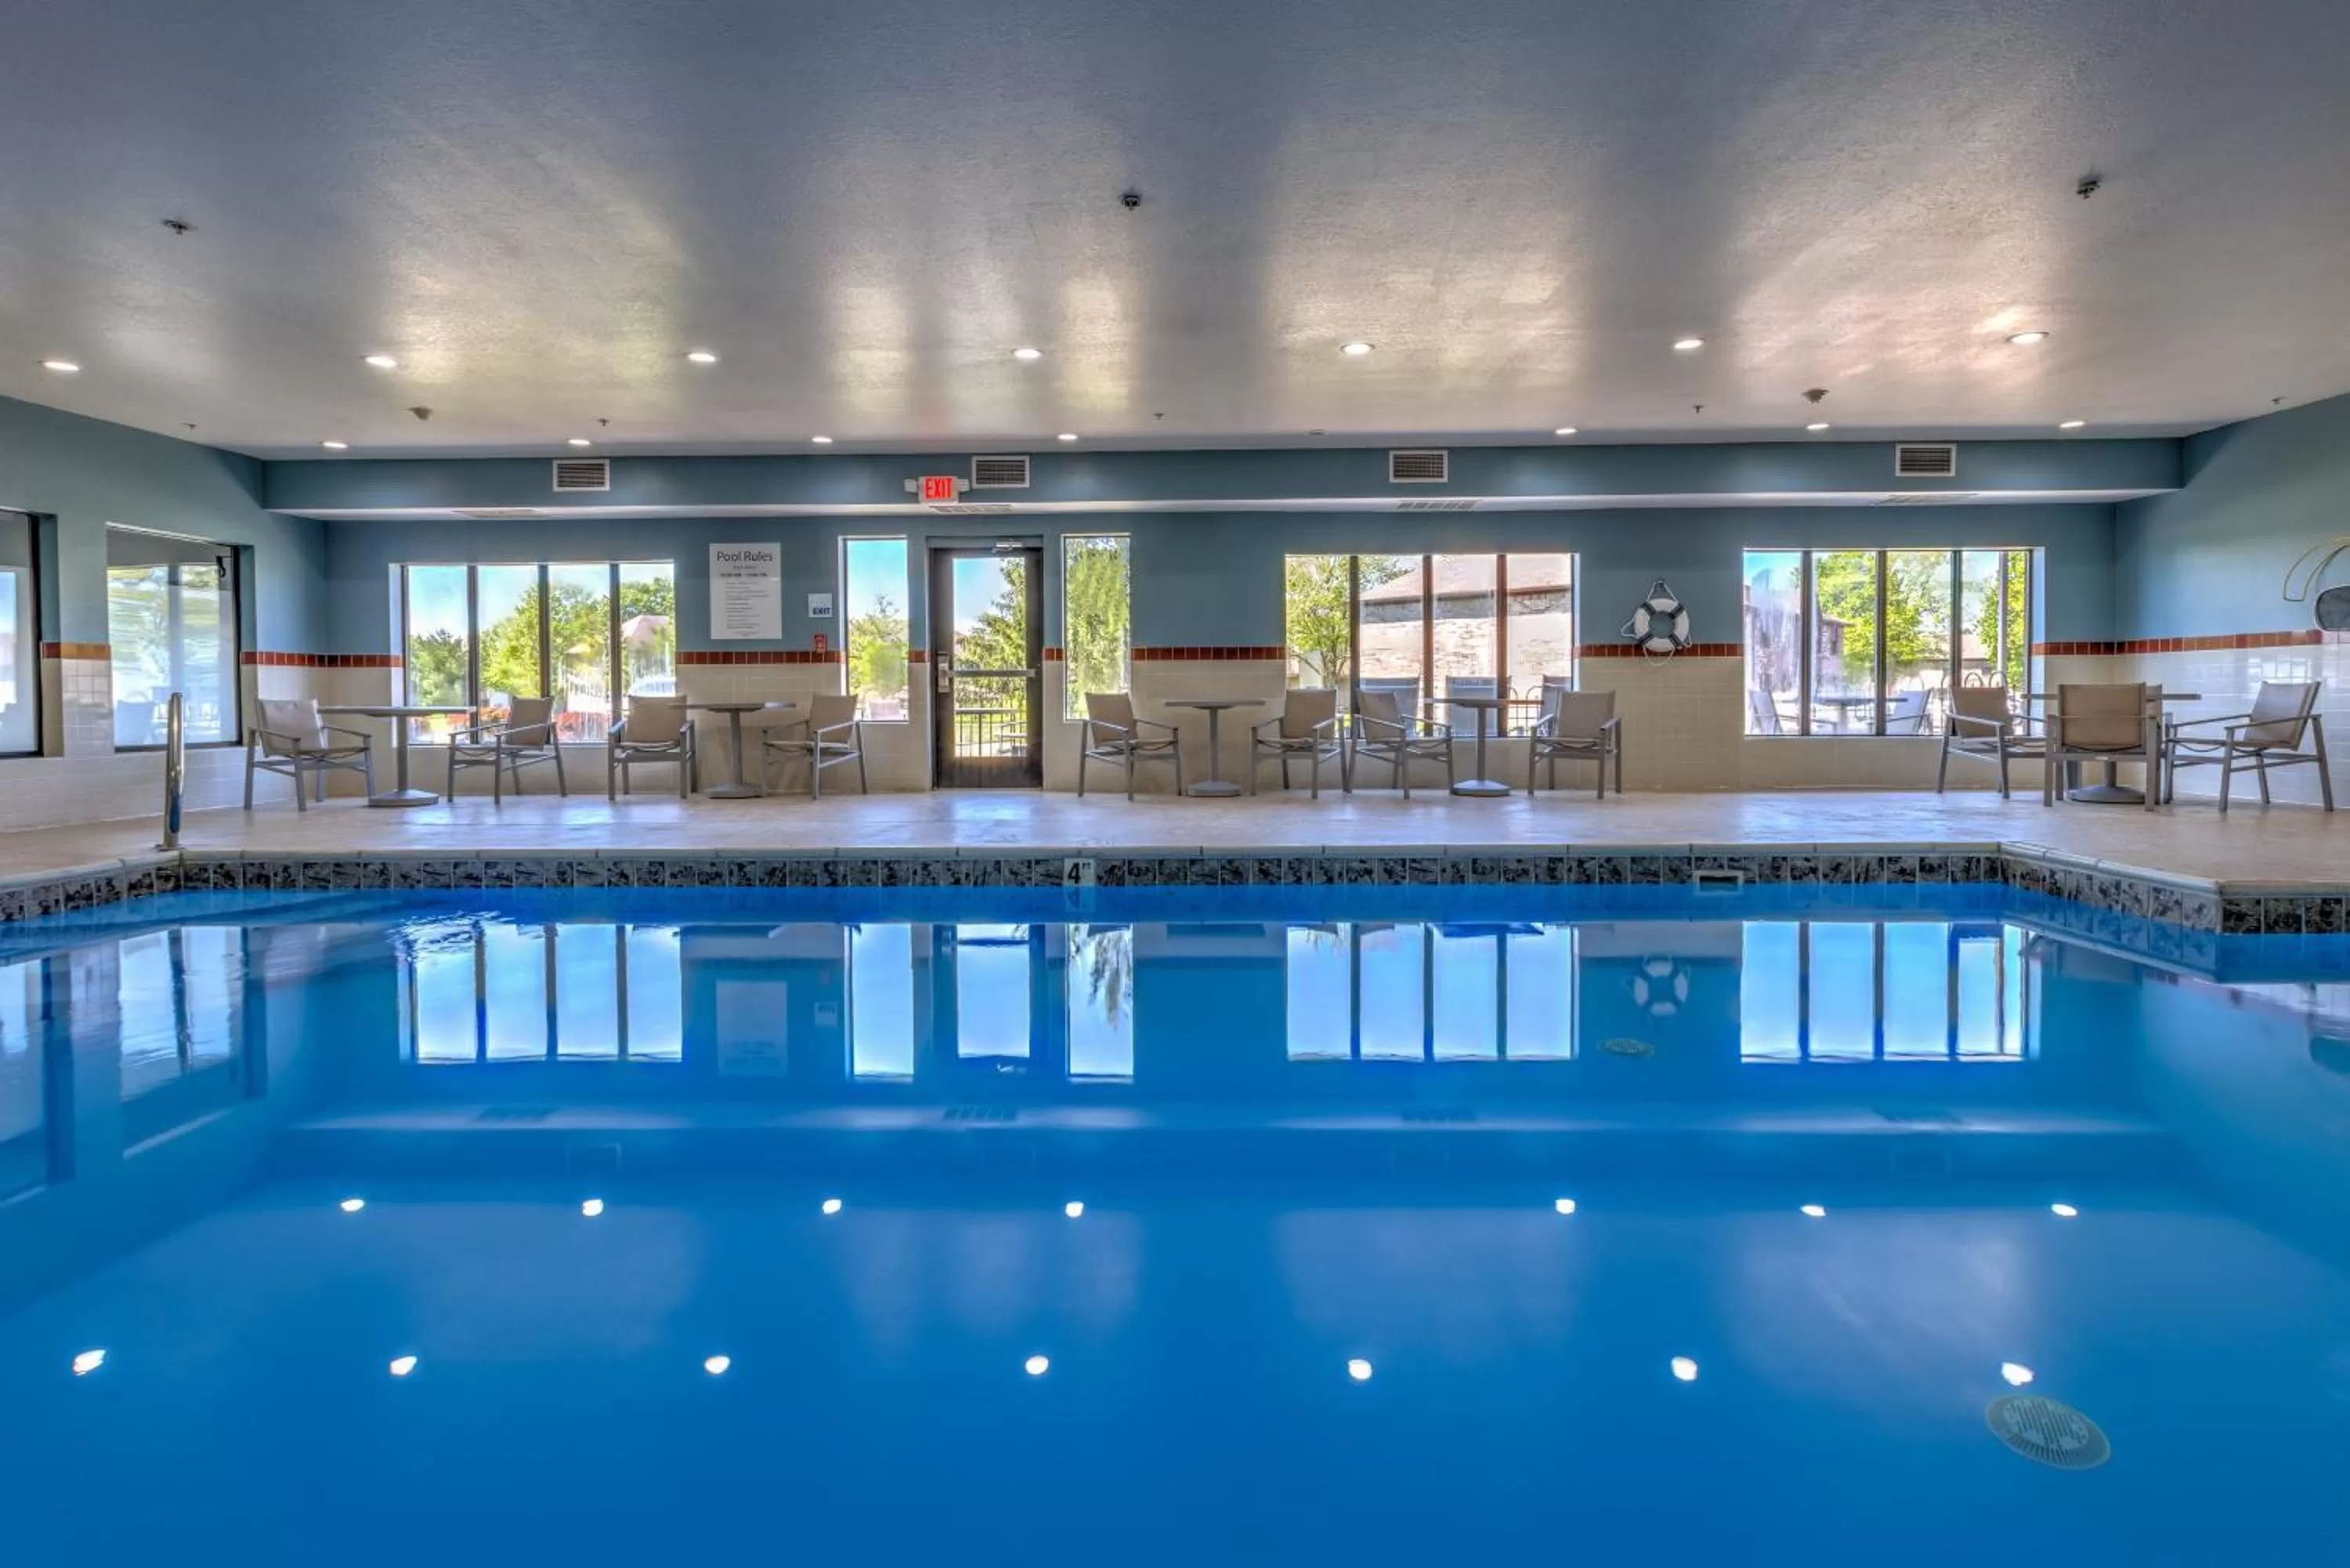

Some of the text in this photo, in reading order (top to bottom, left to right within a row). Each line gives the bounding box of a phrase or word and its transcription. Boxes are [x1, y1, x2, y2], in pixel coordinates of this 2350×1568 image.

[924, 476, 953, 499] EXIT
[717, 551, 774, 562] Pool Rules
